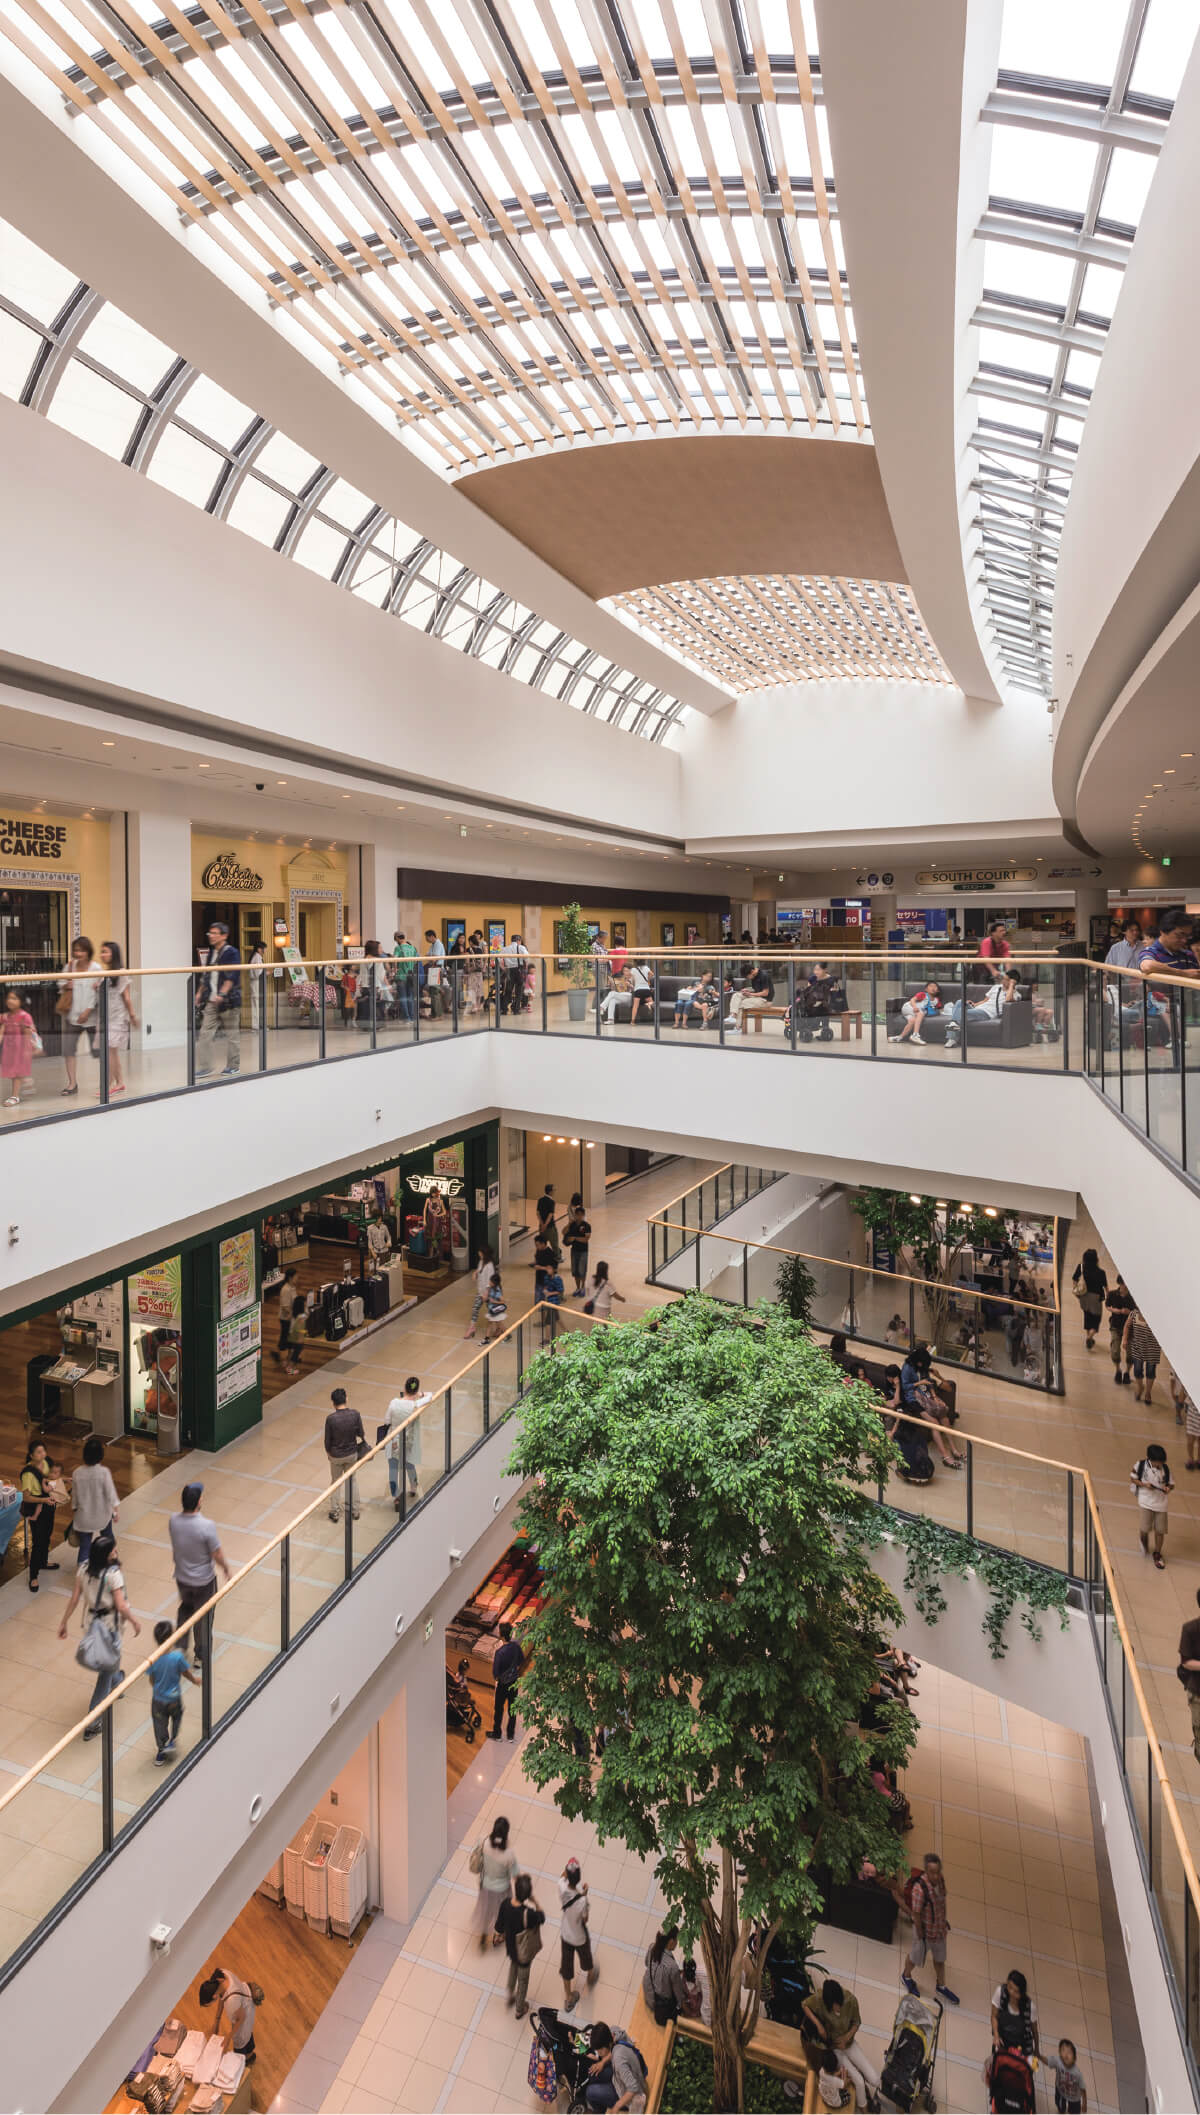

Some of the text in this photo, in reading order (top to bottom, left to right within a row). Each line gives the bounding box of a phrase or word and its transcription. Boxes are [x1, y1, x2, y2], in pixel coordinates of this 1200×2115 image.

[0, 819, 66, 842] CHEESE
[1, 838, 61, 858] CAKES
[932, 870, 1018, 882] SOUTH COURT
[137, 1295, 173, 1314] 5%off
